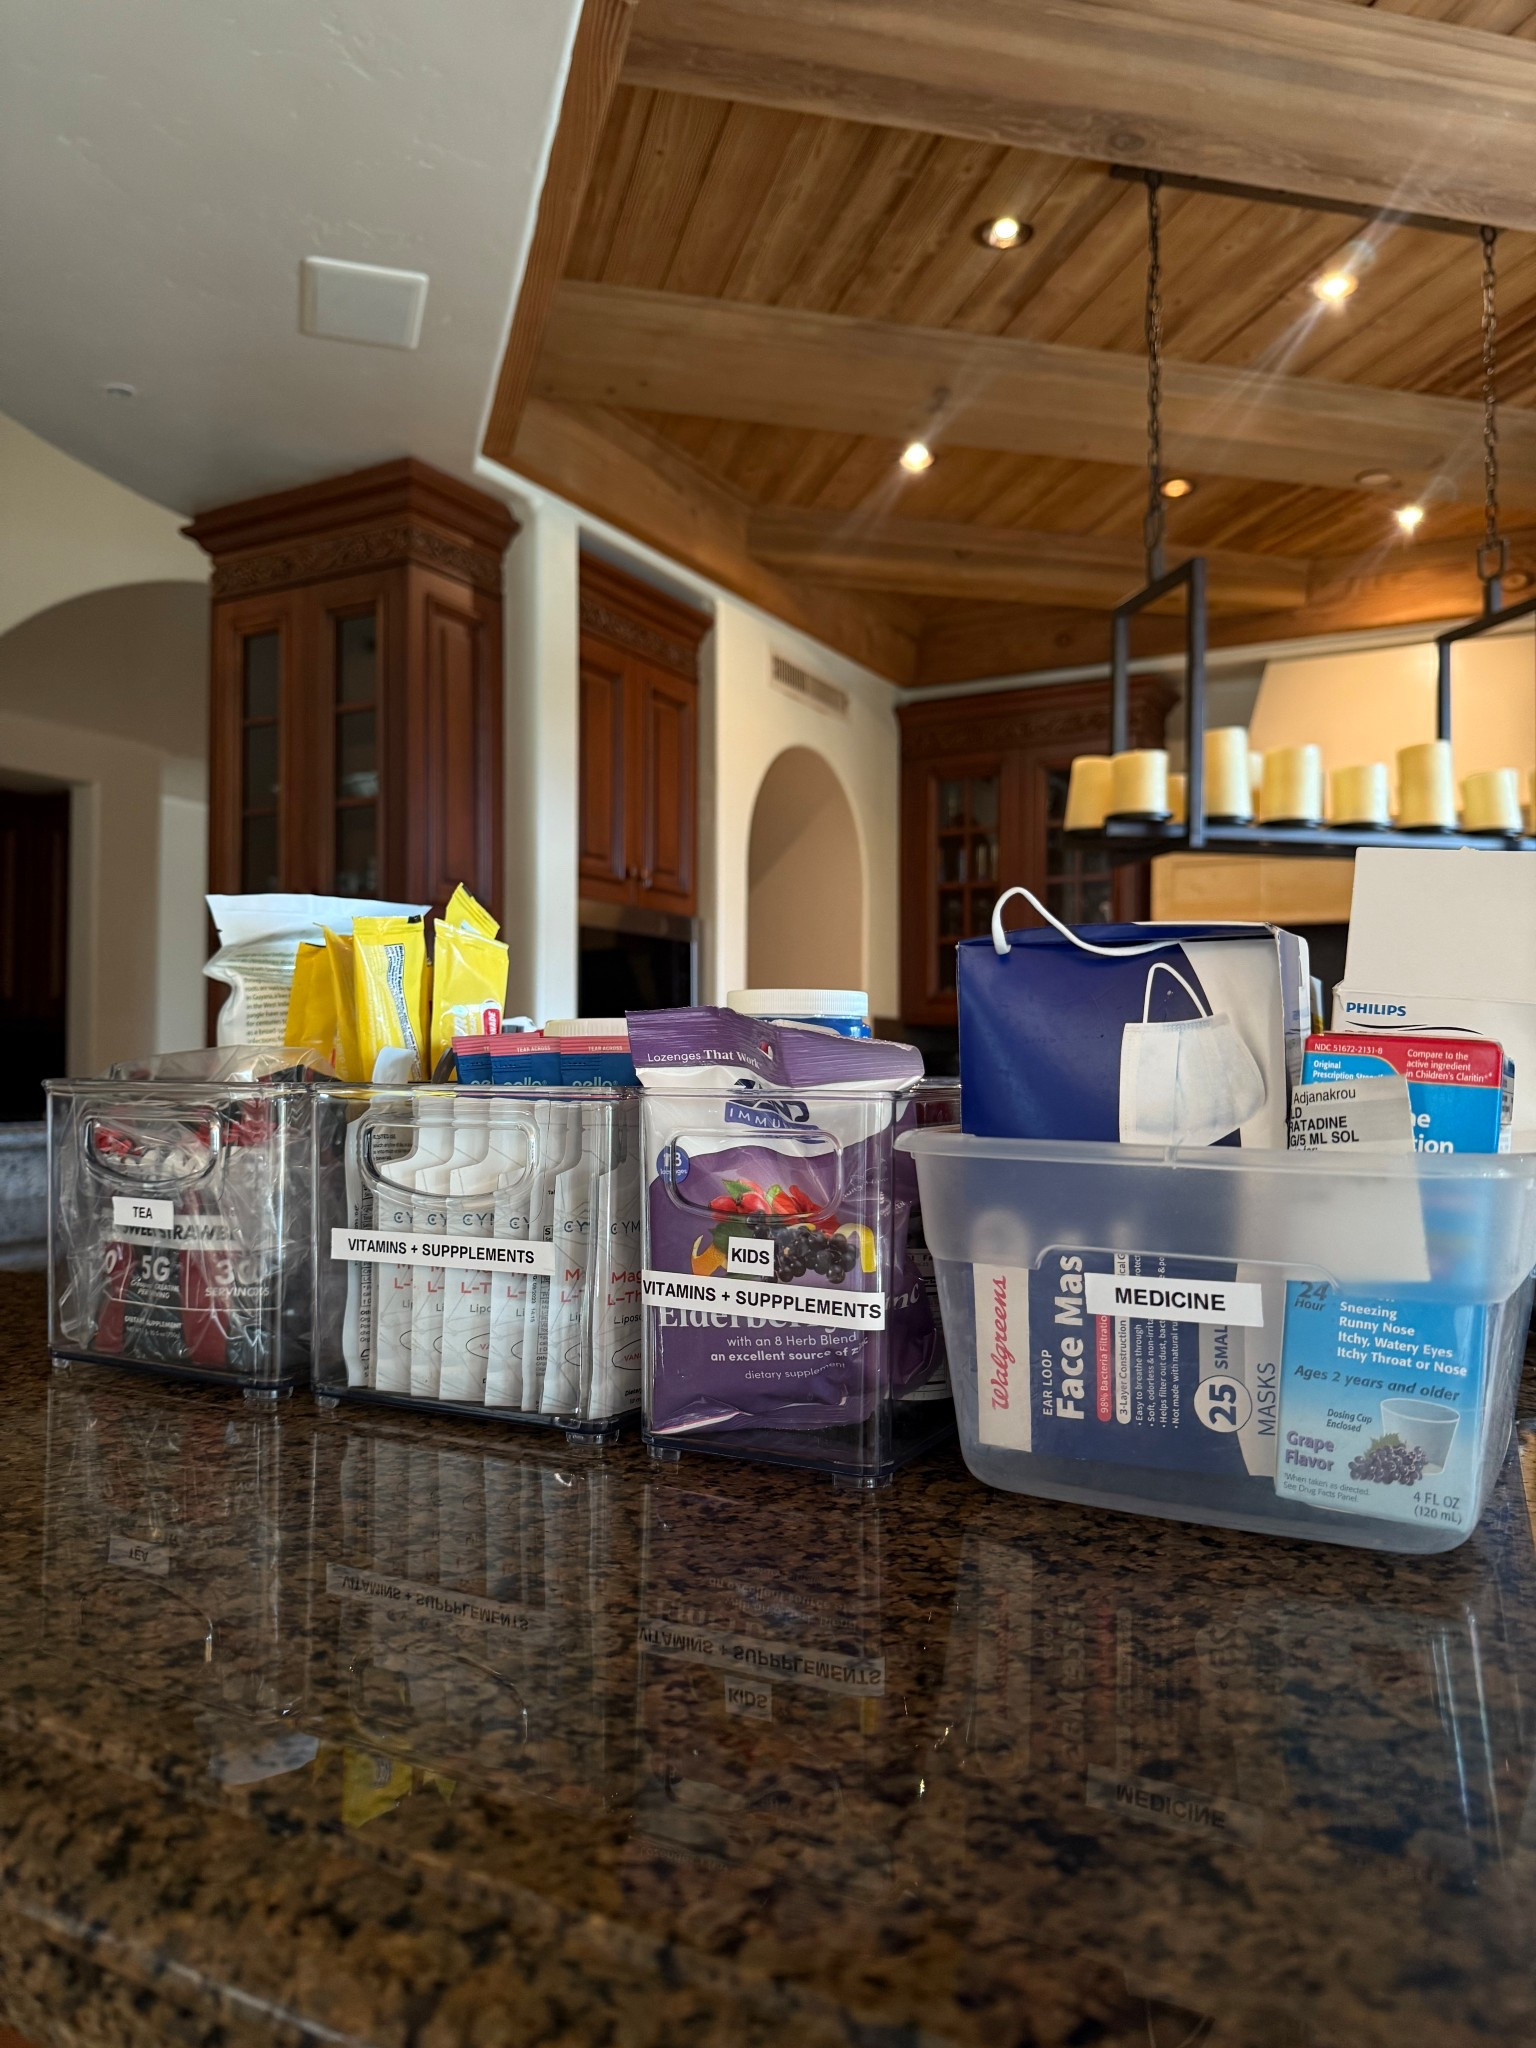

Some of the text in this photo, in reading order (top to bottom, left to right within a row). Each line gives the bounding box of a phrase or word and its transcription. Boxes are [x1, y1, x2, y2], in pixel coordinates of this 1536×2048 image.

[1345, 1002, 1407, 1017] PHILIPS
[647, 1051, 701, 1064] Lozenges
[703, 1049, 735, 1061] That
[1314, 1043, 1383, 1055] NDC 51672-2131-8
[1407, 1048, 1469, 1061] Compare to the
[1313, 1060, 1341, 1070] Original
[1406, 1060, 1471, 1072] active ingredient
[1312, 1070, 1354, 1081] Prescription
[1406, 1070, 1413, 1078] in
[1415, 1070, 1454, 1081] Children's
[1293, 1088, 1356, 1106] Adjanakrou
[1309, 1132, 1328, 1145] ML
[1331, 1130, 1360, 1143] SOL
[132, 1206, 153, 1219] TEA
[348, 1238, 535, 1264] VITAMINS + SUPPPLEMENTS
[731, 1247, 770, 1265] KIDS
[141, 1254, 171, 1282] 5G
[642, 1279, 716, 1302] VITAMINS
[721, 1291, 731, 1302] +
[735, 1290, 882, 1319] SUPPPLEMENTS
[1114, 1286, 1226, 1311] MEDICINE
[1297, 1280, 1331, 1301] 24
[1294, 1297, 1326, 1312] Hour
[1340, 1301, 1398, 1321] Sneezing
[1339, 1316, 1415, 1336] Runny Nose
[726, 1332, 857, 1347] with an 8 Herb Blend
[991, 1274, 1017, 1411] Walgreens
[1117, 1320, 1128, 1379] Construction
[1134, 1324, 1144, 1357] through
[1170, 1332, 1179, 1362] natural
[1338, 1331, 1453, 1359] Itchy, Watery Eyes
[710, 1352, 725, 1362] an
[728, 1350, 785, 1362] excellent
[789, 1349, 831, 1361] source
[835, 1346, 848, 1357] of
[1158, 1339, 1167, 1361] dust,
[744, 1361, 847, 1381] dietary supplement
[1159, 1362, 1167, 1377] out
[1337, 1347, 1467, 1377] Itchy Throat or Nose
[1041, 1348, 1054, 1416] EAR LOOP
[1055, 1336, 1086, 1421] Face
[1100, 1353, 1109, 1392] Bacteria
[1134, 1357, 1143, 1390] breathe
[1146, 1365, 1155, 1400] odorless
[1170, 1363, 1179, 1382] with
[1159, 1377, 1167, 1398] filter
[1294, 1365, 1461, 1402] Ages 2 years and older
[1100, 1392, 1109, 1414] 98%
[1119, 1380, 1129, 1416] 3-Layer
[1135, 1391, 1143, 1400] to
[1171, 1384, 1179, 1407] made
[1208, 1382, 1237, 1426] 25
[1256, 1361, 1276, 1437] MASKS
[1135, 1402, 1144, 1421] Easy
[1147, 1401, 1156, 1422] Soft,
[1159, 1399, 1168, 1423] Helps
[1171, 1407, 1180, 1424] Not
[1327, 1408, 1373, 1425] Dosing Cup
[1326, 1418, 1362, 1433] Enclosed
[1286, 1430, 1335, 1453] Grape
[1284, 1449, 1335, 1472] Flavor
[1283, 1481, 1297, 1491] See
[1298, 1483, 1317, 1496] Drug
[1317, 1487, 1336, 1498] Facts
[1308, 1477, 1328, 1488] taken
[1330, 1482, 1338, 1490] as
[1413, 1491, 1460, 1510] 4 FL OZ
[1414, 1505, 1463, 1525] (120 mL)
